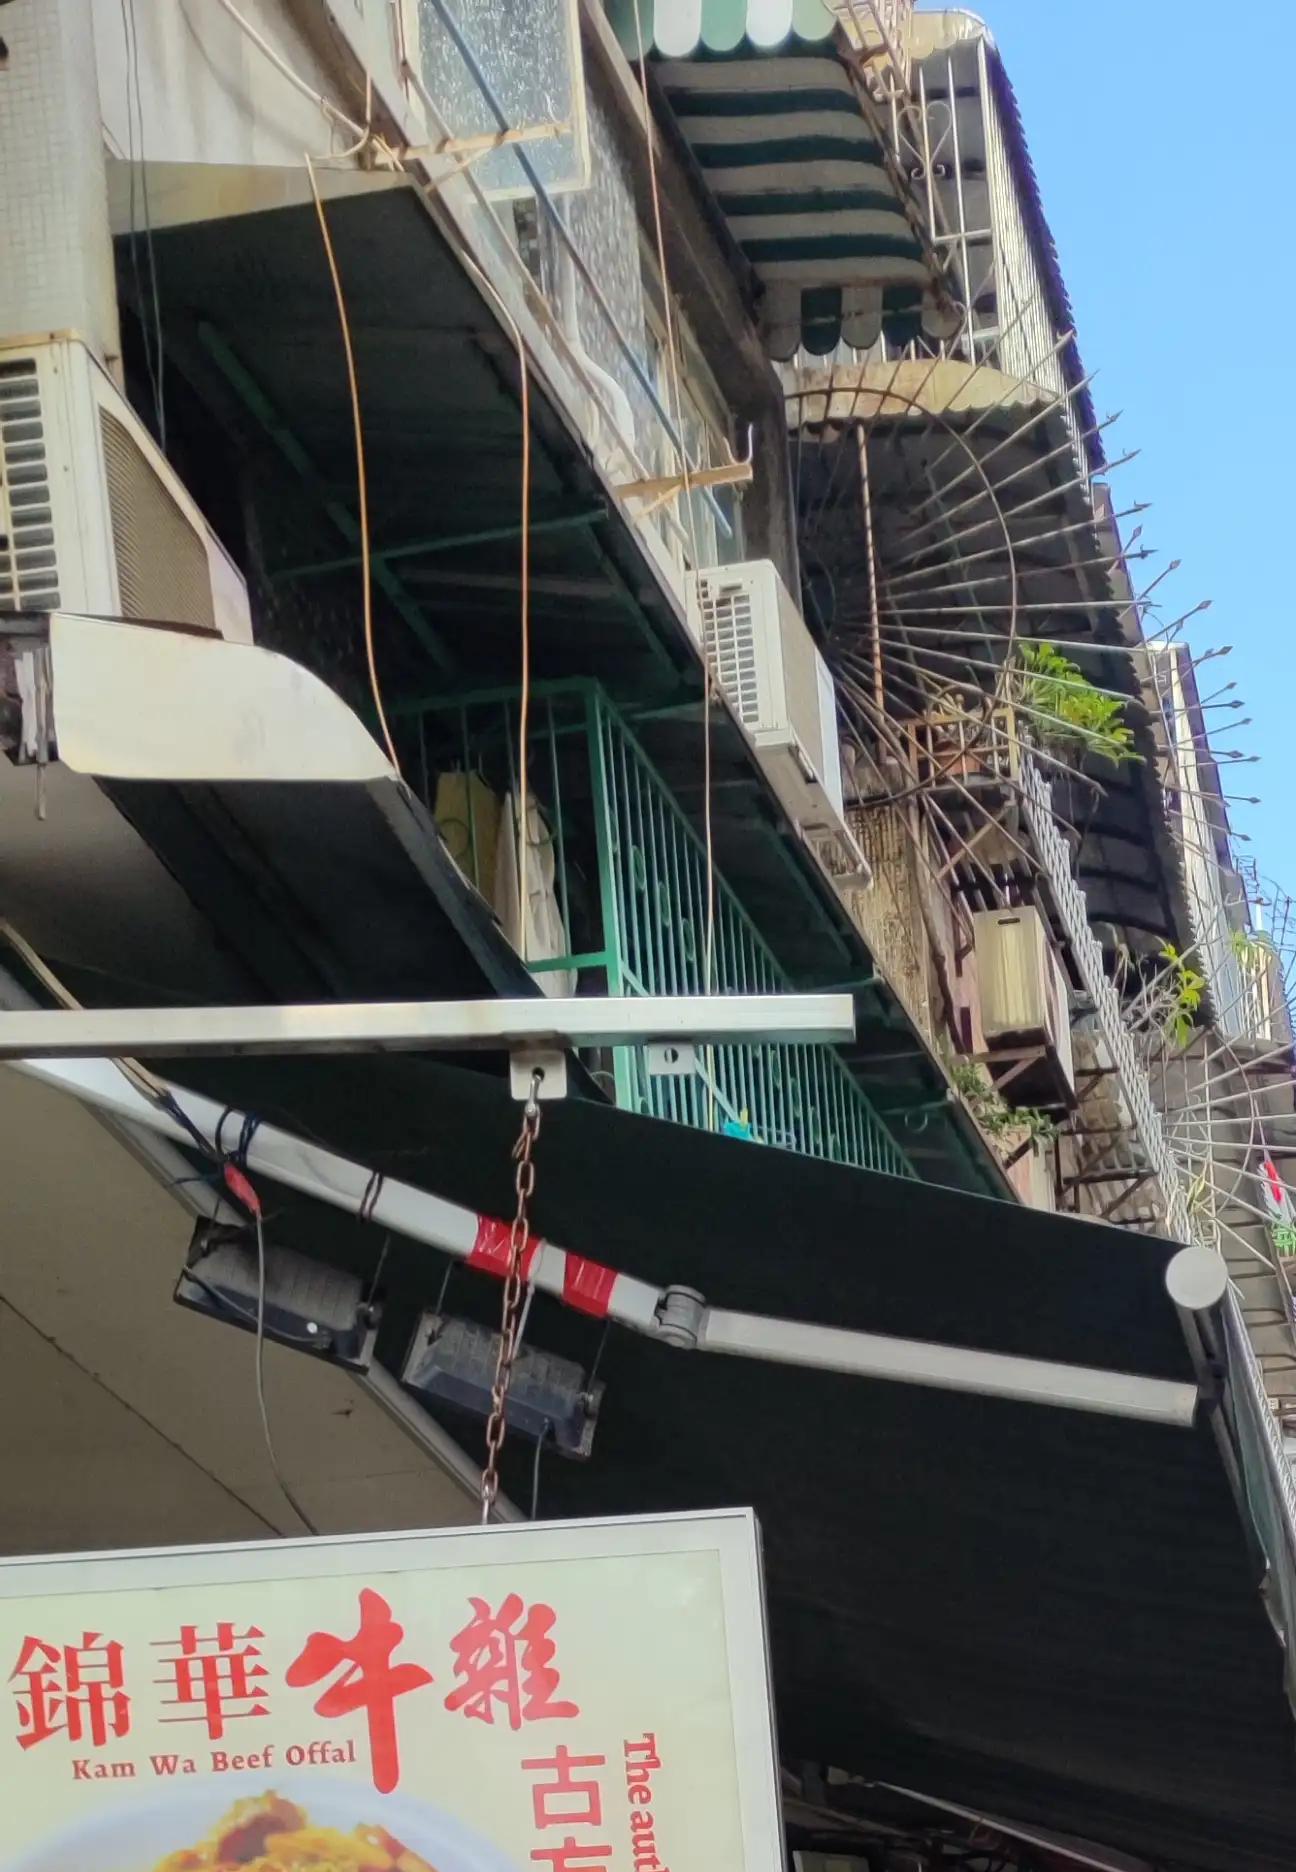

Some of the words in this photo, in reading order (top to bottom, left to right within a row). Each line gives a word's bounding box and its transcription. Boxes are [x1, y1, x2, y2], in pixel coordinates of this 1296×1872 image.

[7, 1586, 581, 1795] 錦華牛雜
[71, 1756, 136, 1782] Kam
[150, 1754, 197, 1777] Wa
[210, 1745, 274, 1773] Beef
[284, 1740, 357, 1768] Offal
[623, 1732, 662, 1806] The
